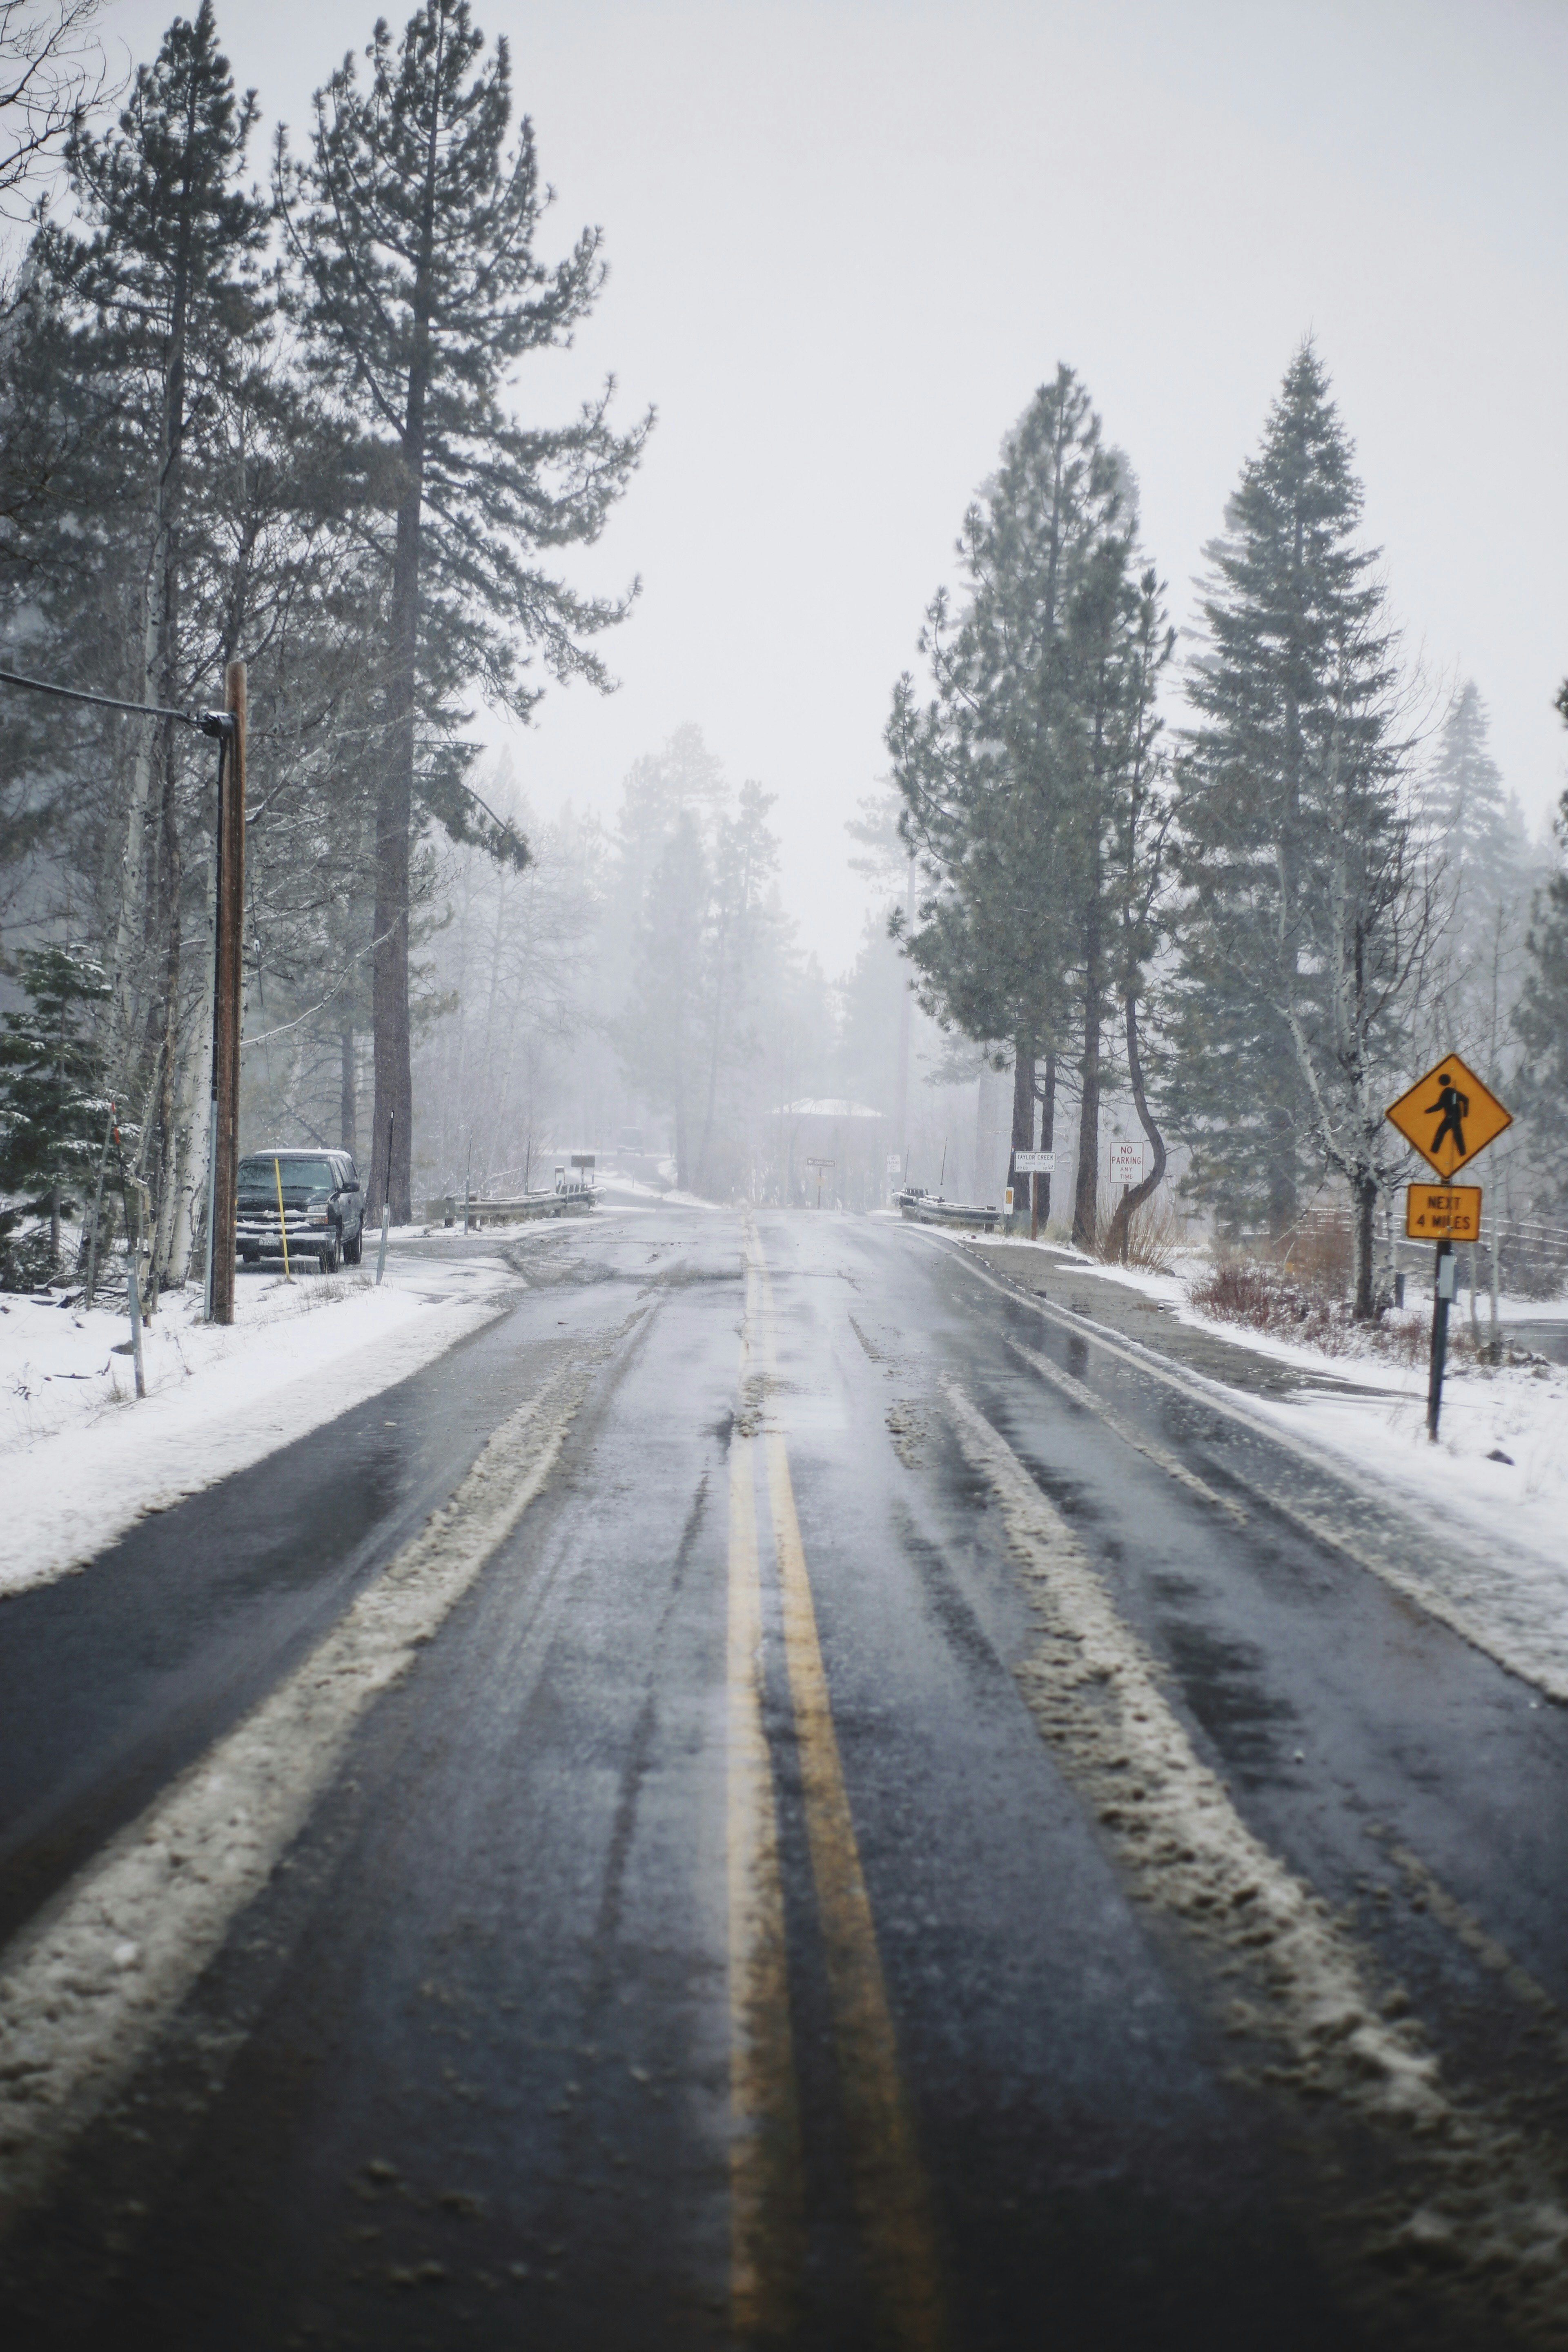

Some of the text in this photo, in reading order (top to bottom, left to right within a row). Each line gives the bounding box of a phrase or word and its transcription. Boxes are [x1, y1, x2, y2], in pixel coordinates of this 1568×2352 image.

[1427, 1196, 1461, 1210] NEXT
[1417, 1214, 1470, 1229] 4 MILES
